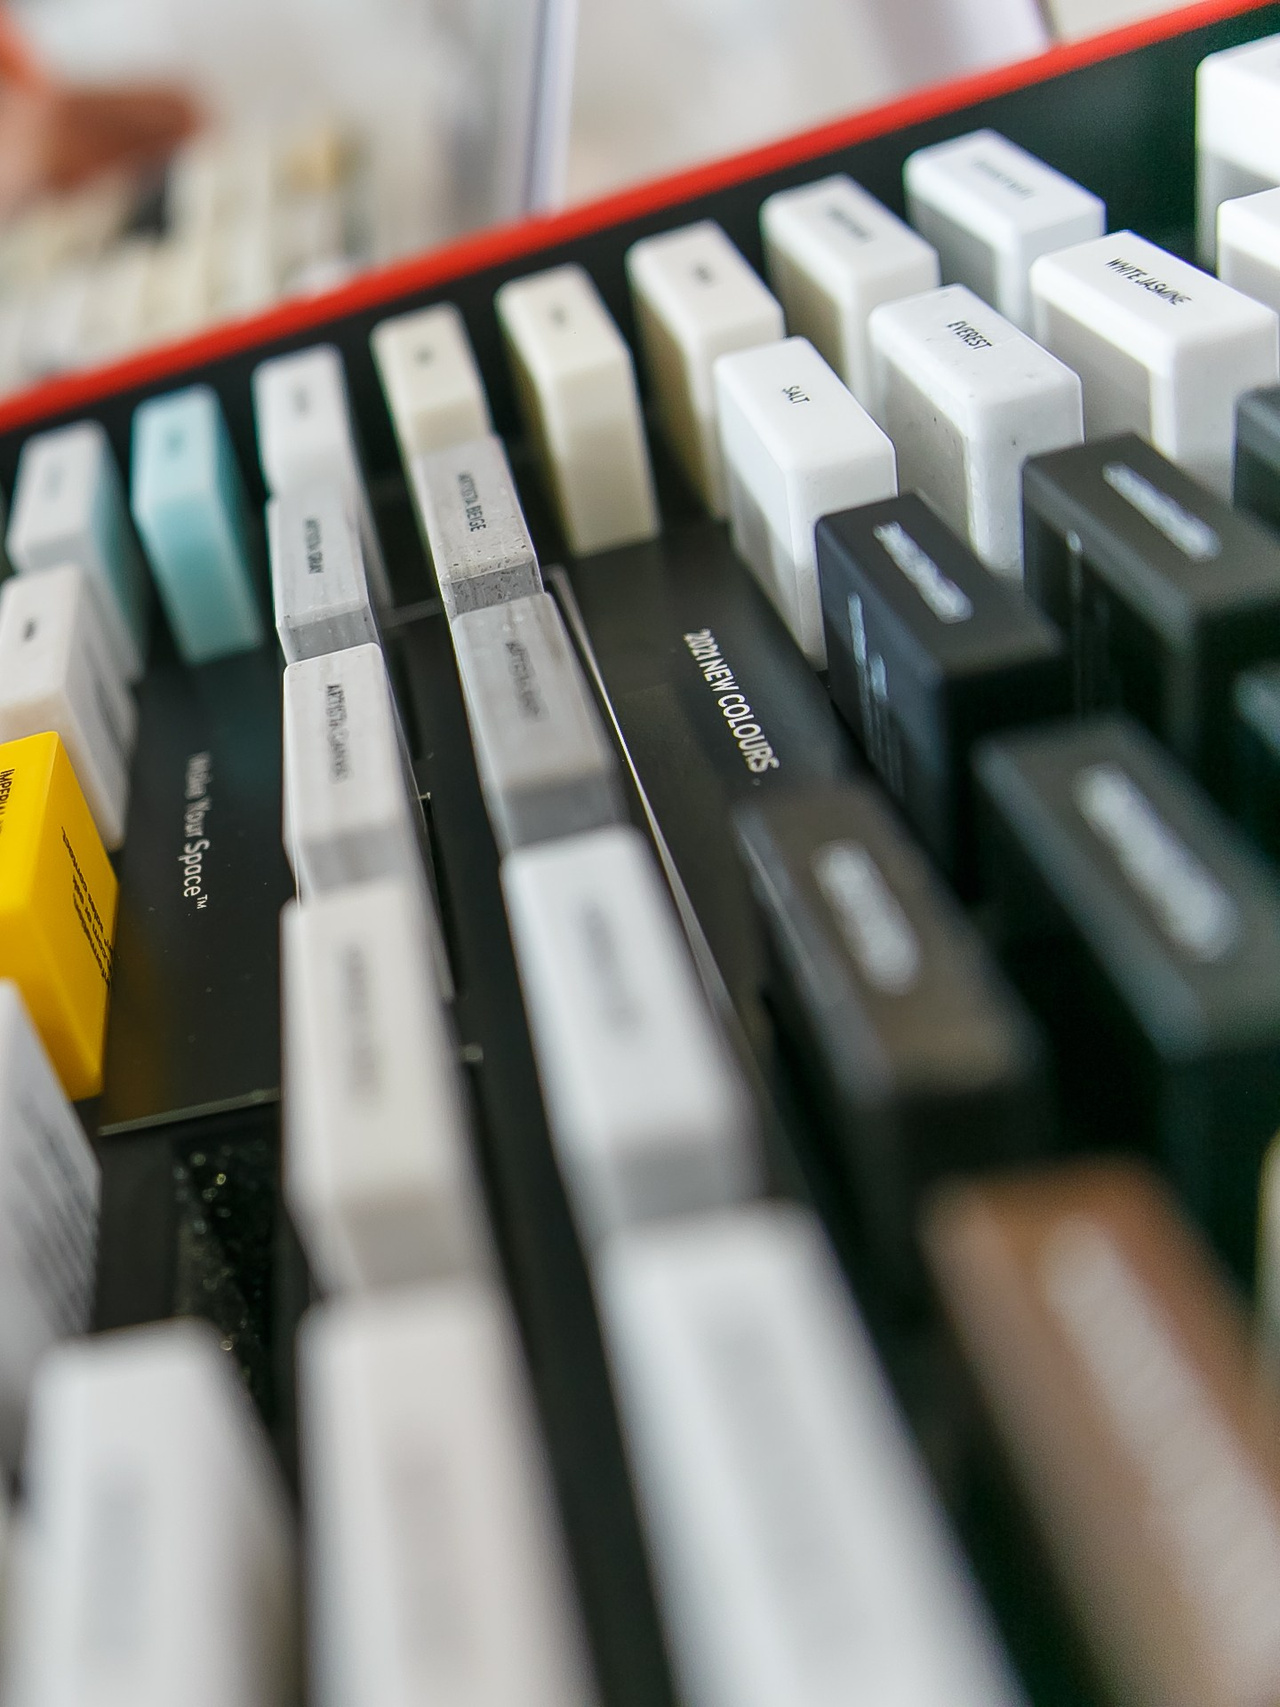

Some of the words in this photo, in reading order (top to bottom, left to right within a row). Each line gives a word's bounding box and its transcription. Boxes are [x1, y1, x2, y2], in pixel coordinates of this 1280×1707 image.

[1105, 257, 1147, 280] WHITE
[1135, 277, 1192, 305] JASMINE
[946, 321, 992, 350] EVEREST
[782, 385, 810, 404] SALT
[466, 505, 486, 532] BEIGE
[682, 628, 721, 661] 2021
[699, 657, 740, 692] NEW
[717, 693, 780, 774] COLOURS
